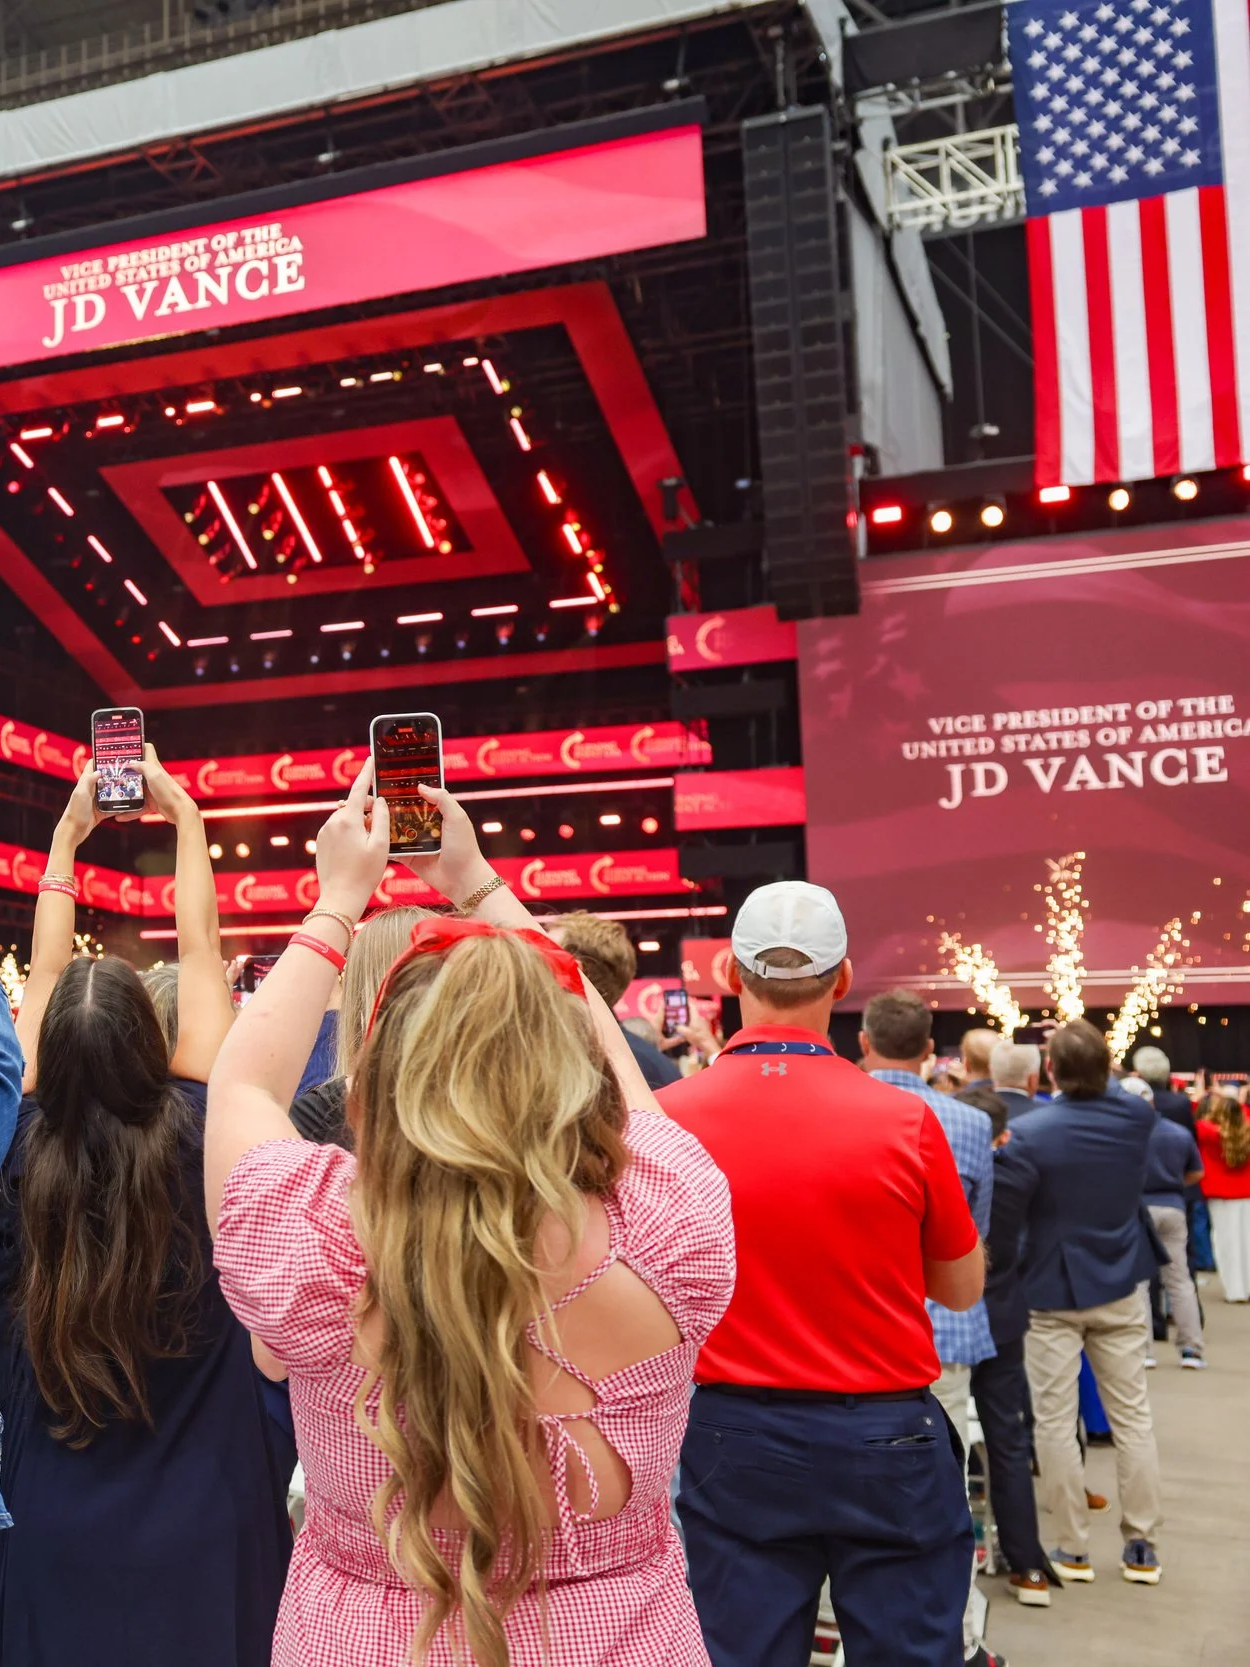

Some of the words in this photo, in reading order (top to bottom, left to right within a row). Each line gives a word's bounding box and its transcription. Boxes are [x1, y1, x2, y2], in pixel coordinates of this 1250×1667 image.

[43, 273, 112, 300] UNITED
[115, 257, 181, 286] STATES
[184, 250, 213, 270] OF
[214, 235, 304, 267] AMERICA
[60, 259, 103, 281] VICE
[107, 238, 209, 273] PRESIDENT
[210, 231, 239, 251] OF
[240, 223, 282, 243] THE
[42, 293, 106, 348] JD
[120, 252, 306, 321] VANCE
[901, 736, 995, 760] UNITED
[1001, 729, 1091, 754] STATES
[1095, 726, 1133, 747] OF
[928, 714, 987, 735] VICE
[993, 702, 1132, 731] PRESIDENT
[1135, 699, 1174, 720] OF
[1176, 694, 1236, 717] THE
[938, 761, 1009, 810] JD
[1023, 746, 1229, 794] VANCE
